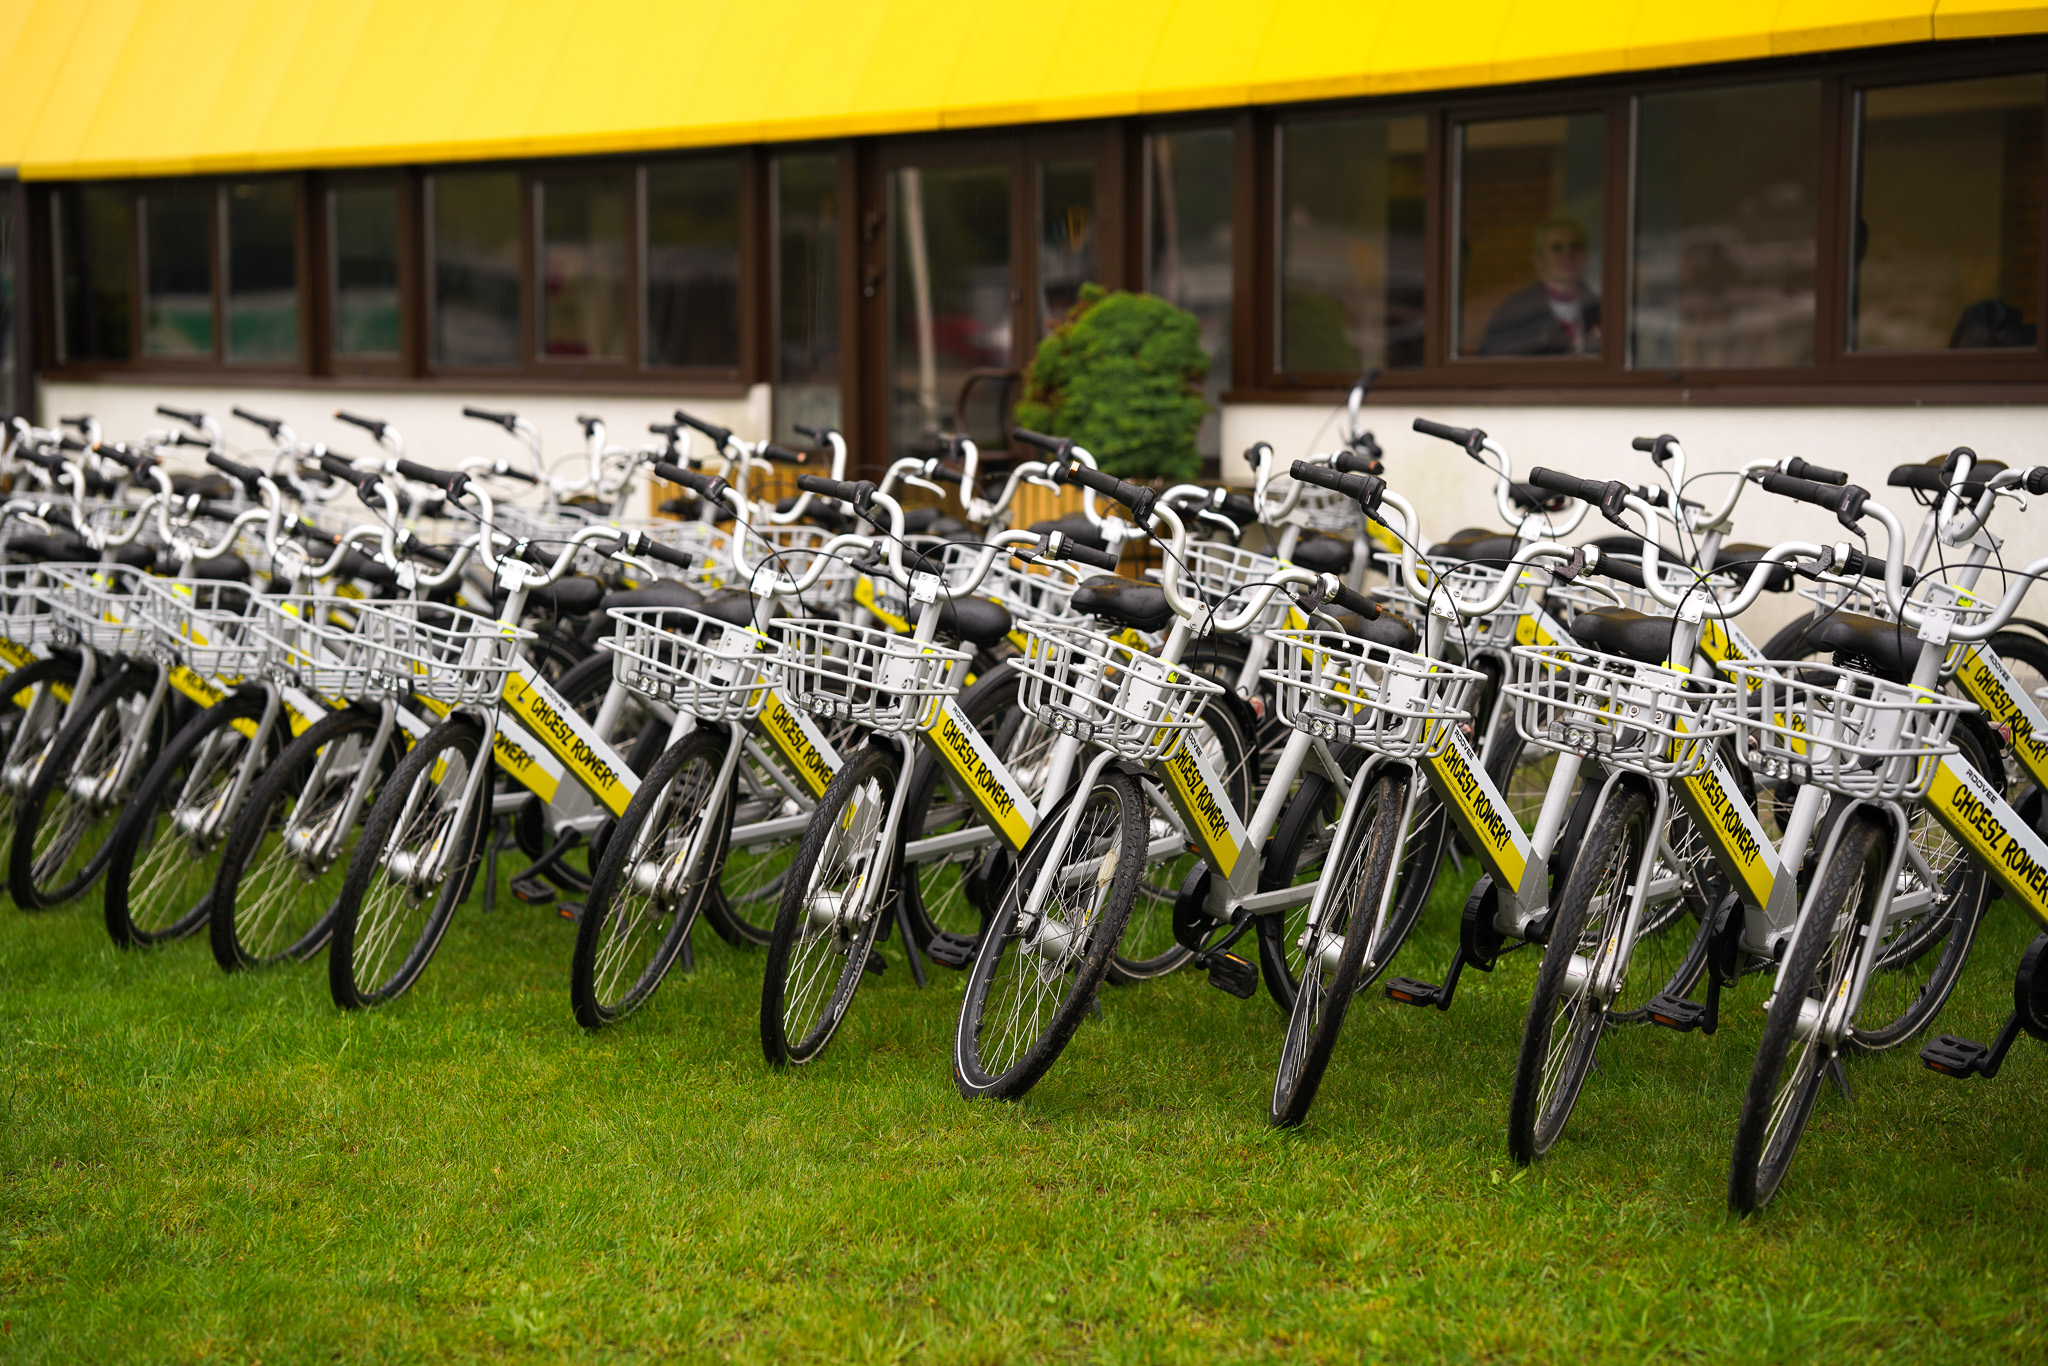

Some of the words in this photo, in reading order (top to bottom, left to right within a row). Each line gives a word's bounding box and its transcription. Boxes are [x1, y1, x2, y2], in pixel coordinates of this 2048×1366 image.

[1974, 665, 2015, 717] CHCESZ
[1988, 653, 2011, 682] ROOVEE
[530, 696, 576, 747] CHCESZ
[571, 738, 620, 791] ROWER?
[772, 703, 809, 753] CHCESZ
[952, 706, 974, 735] ROOVEE
[1188, 732, 1203, 758] OOVEE
[1454, 729, 1475, 760] ROOVEE
[493, 730, 536, 772] OWER?
[942, 718, 980, 772] CHCESZ
[974, 762, 1015, 818] ROWER?
[1443, 742, 1479, 801] CHCESZ
[1473, 790, 1512, 852] ROWER?
[1965, 768, 1998, 805] ROOVEE
[1196, 785, 1230, 842] ROWER?
[1722, 804, 1761, 867] ROWER?
[1951, 784, 2007, 850] CHCESZ
[2001, 838, 2048, 908] ROWER
